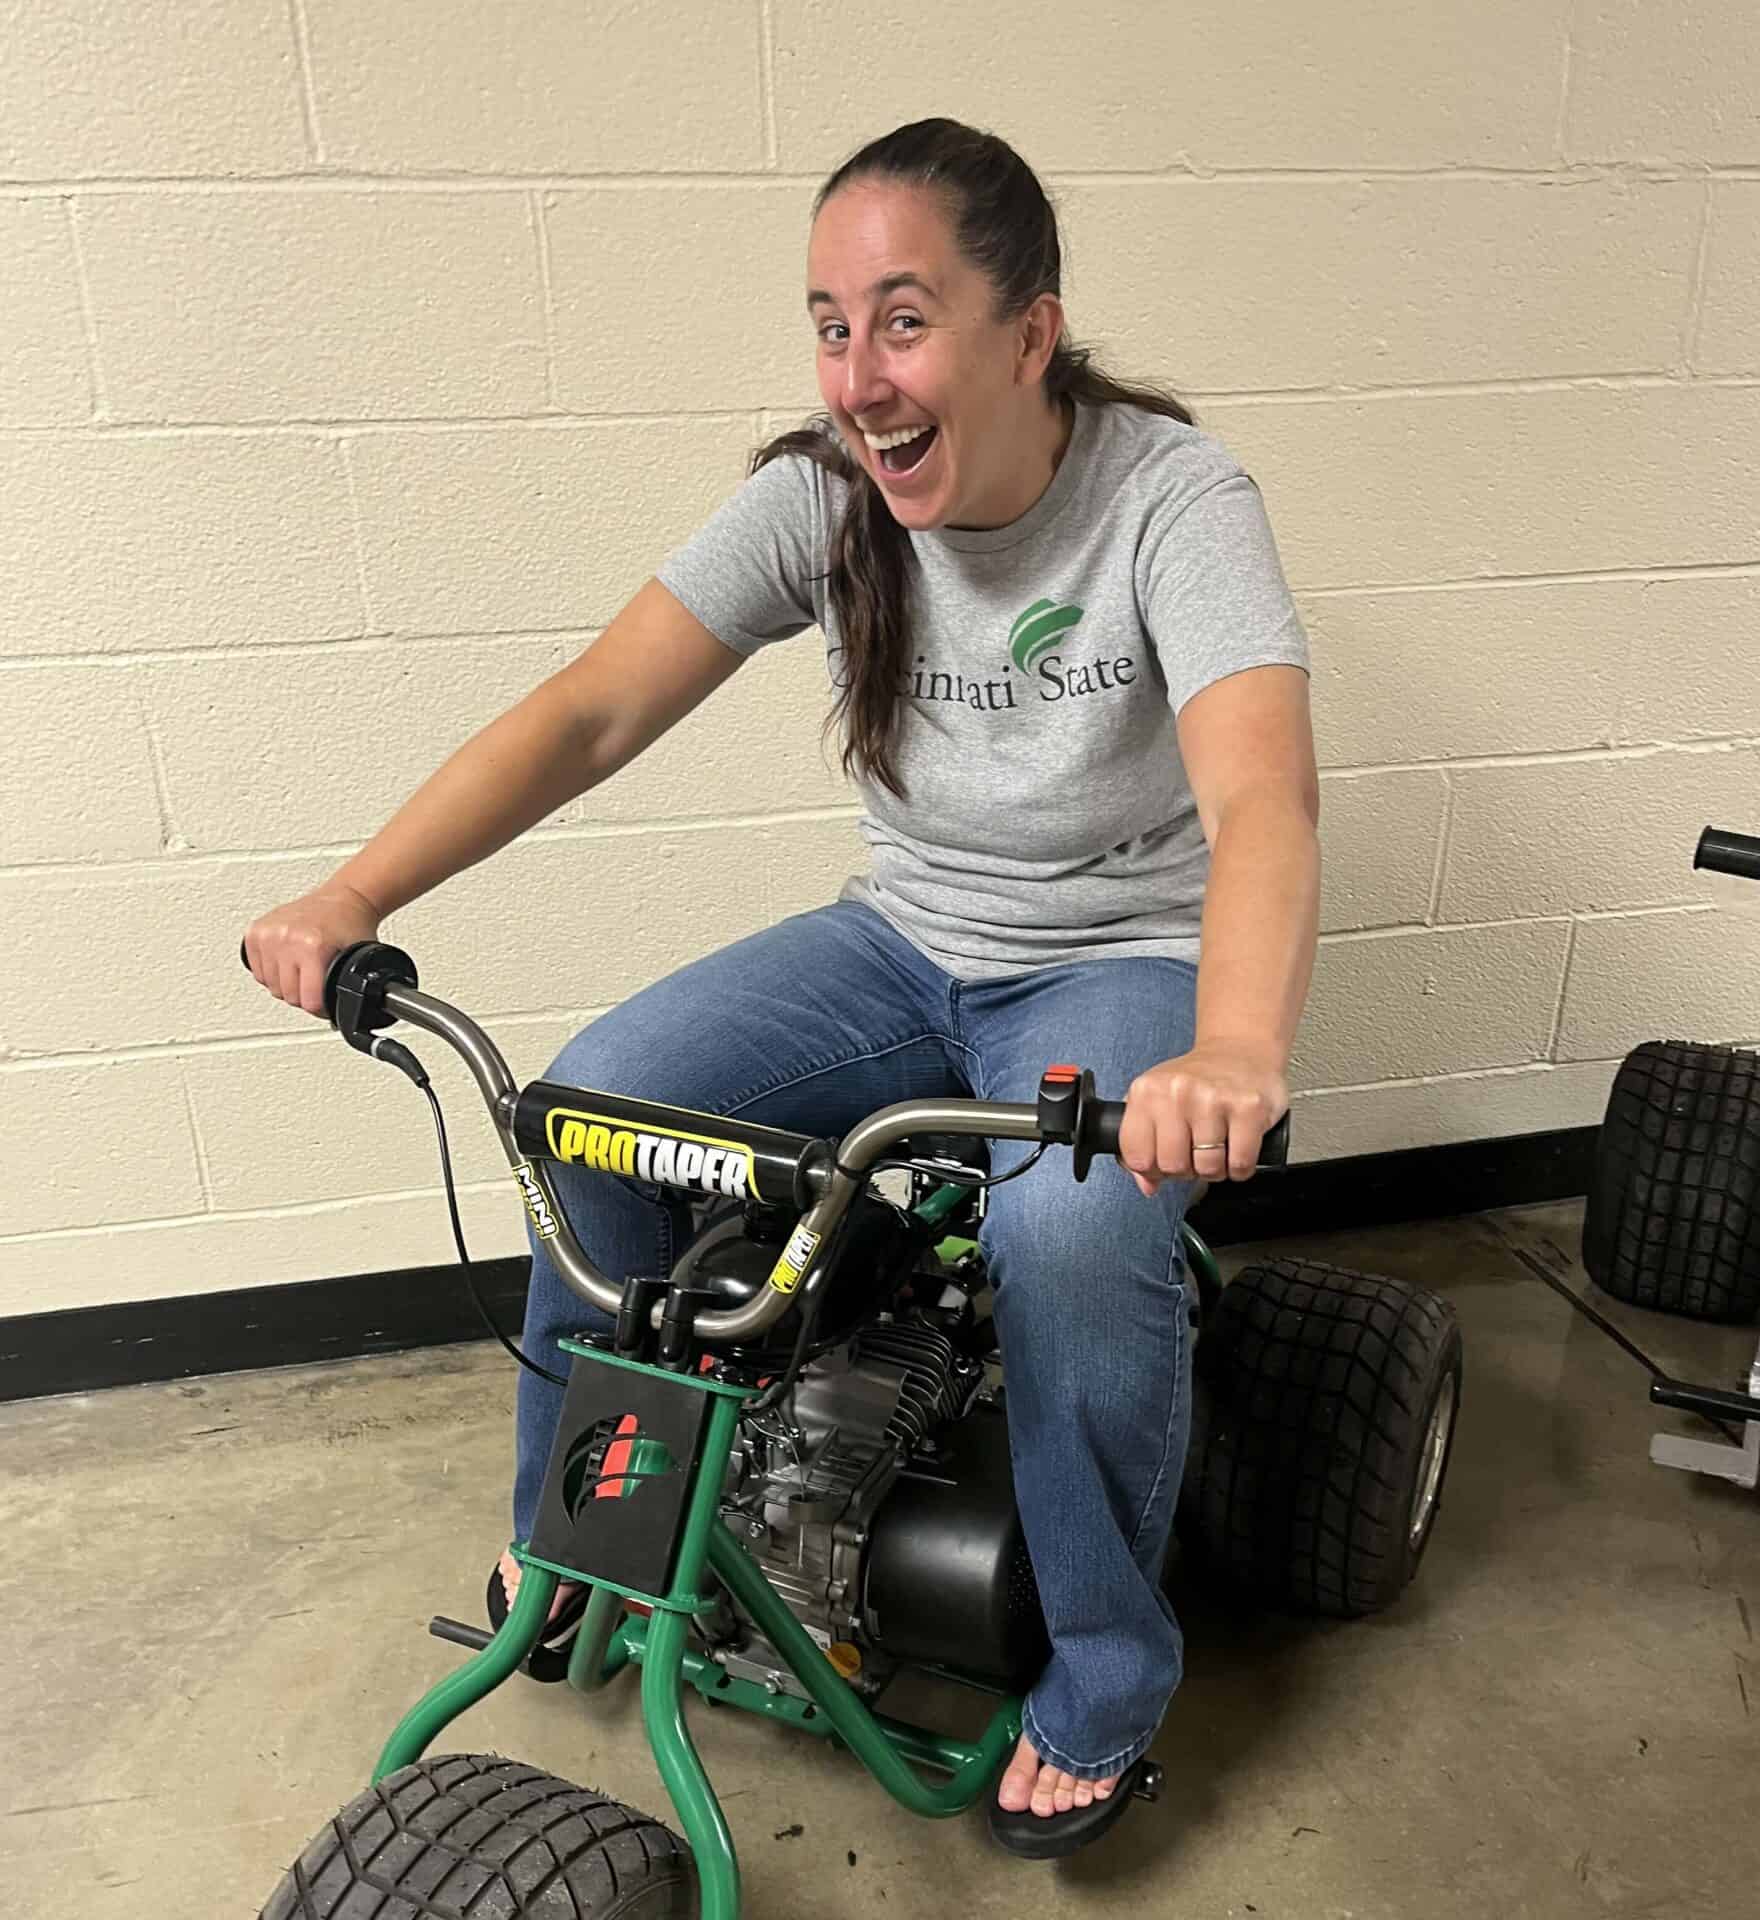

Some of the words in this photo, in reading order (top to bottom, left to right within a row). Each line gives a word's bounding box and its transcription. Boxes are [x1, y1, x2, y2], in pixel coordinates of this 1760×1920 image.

[1038, 655, 1137, 701] State
[559, 1119, 749, 1199] PROTAPER
[517, 1166, 556, 1235] MINI
